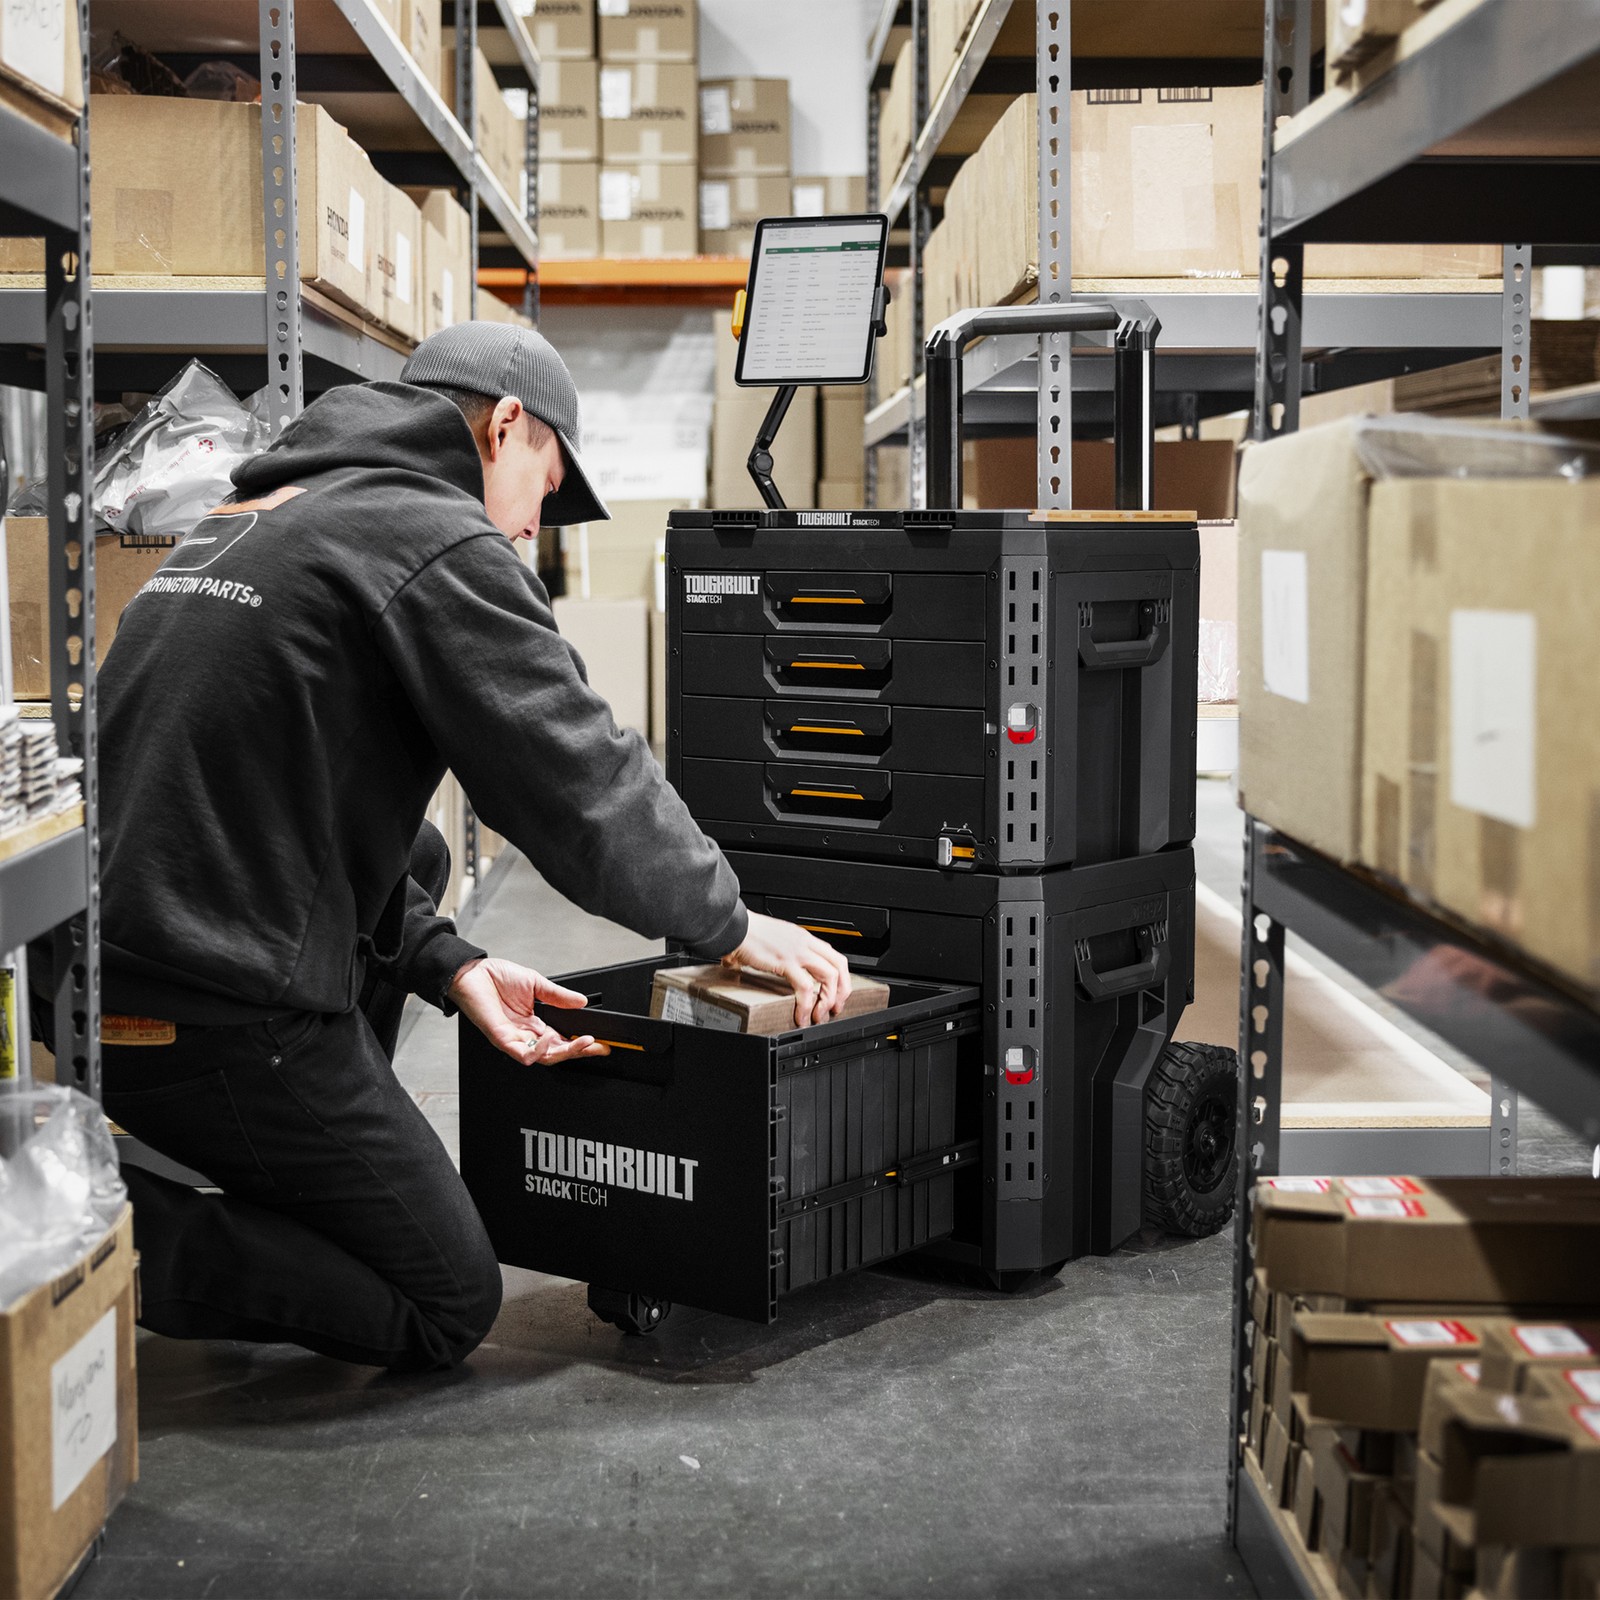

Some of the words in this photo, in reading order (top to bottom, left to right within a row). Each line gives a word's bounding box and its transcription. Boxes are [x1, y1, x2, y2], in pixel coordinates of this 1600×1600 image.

[326, 206, 349, 241] HONDA
[796, 512, 852, 526] TOUGHBUILT
[684, 575, 761, 595] TOUGHBUILT
[686, 595, 723, 604] STACKTECH
[520, 1127, 699, 1202] TOUGHBUILT
[525, 1173, 608, 1208] STACKTECH
